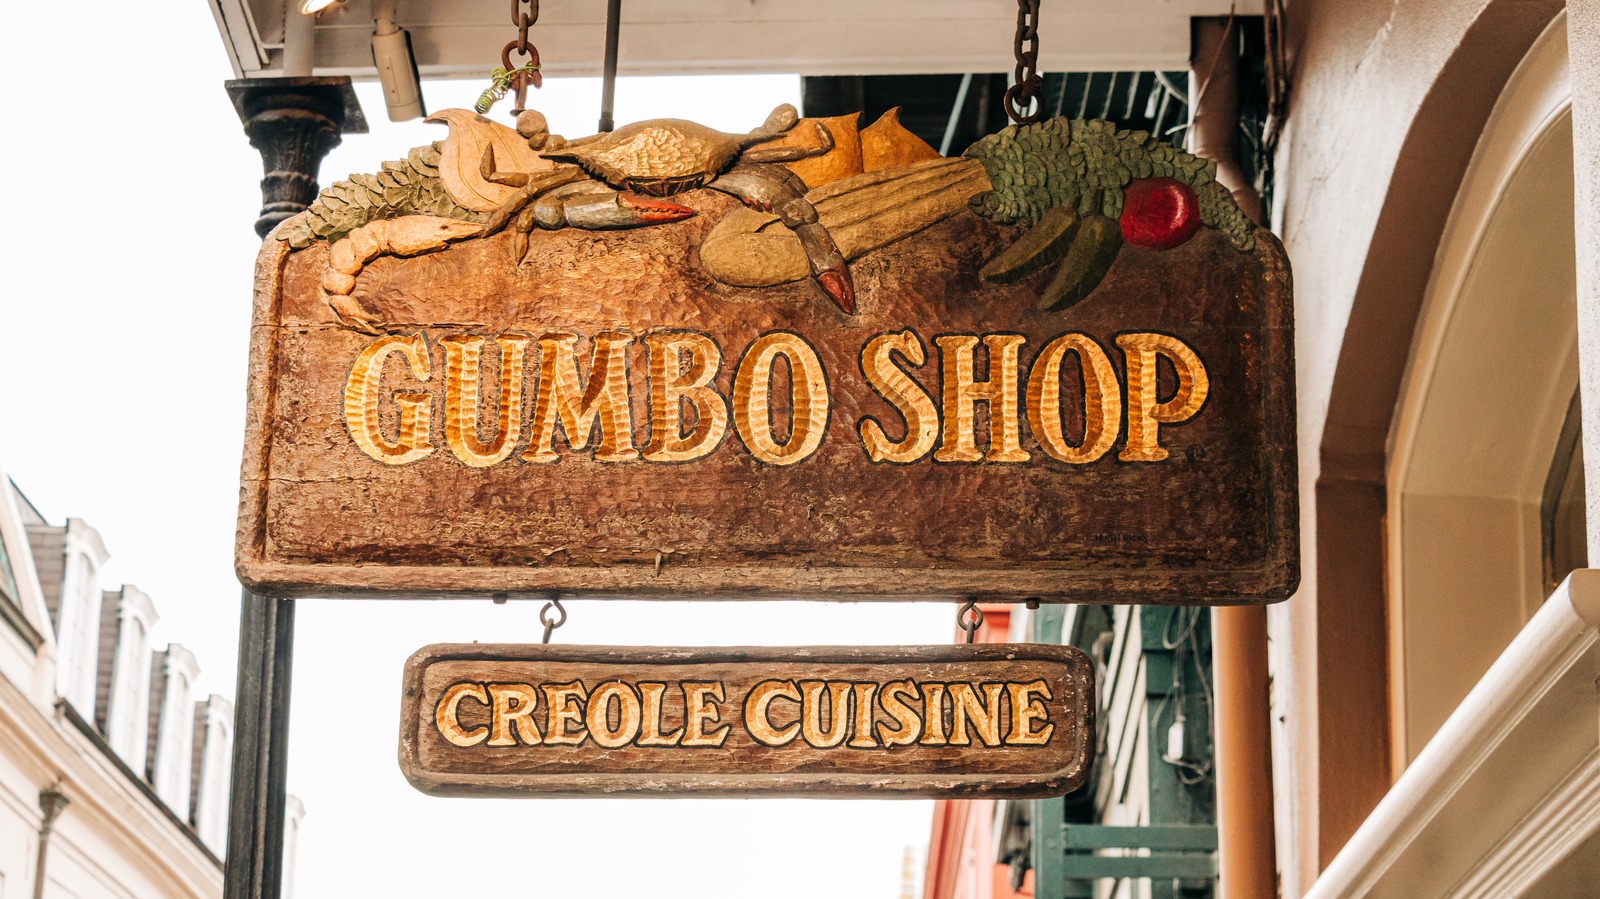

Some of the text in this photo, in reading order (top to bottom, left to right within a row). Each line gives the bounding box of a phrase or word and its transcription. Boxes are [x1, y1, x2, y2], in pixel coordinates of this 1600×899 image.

[343, 329, 1211, 468] GUMBO SHOP
[434, 678, 1055, 748] CREOLE CUISINE
